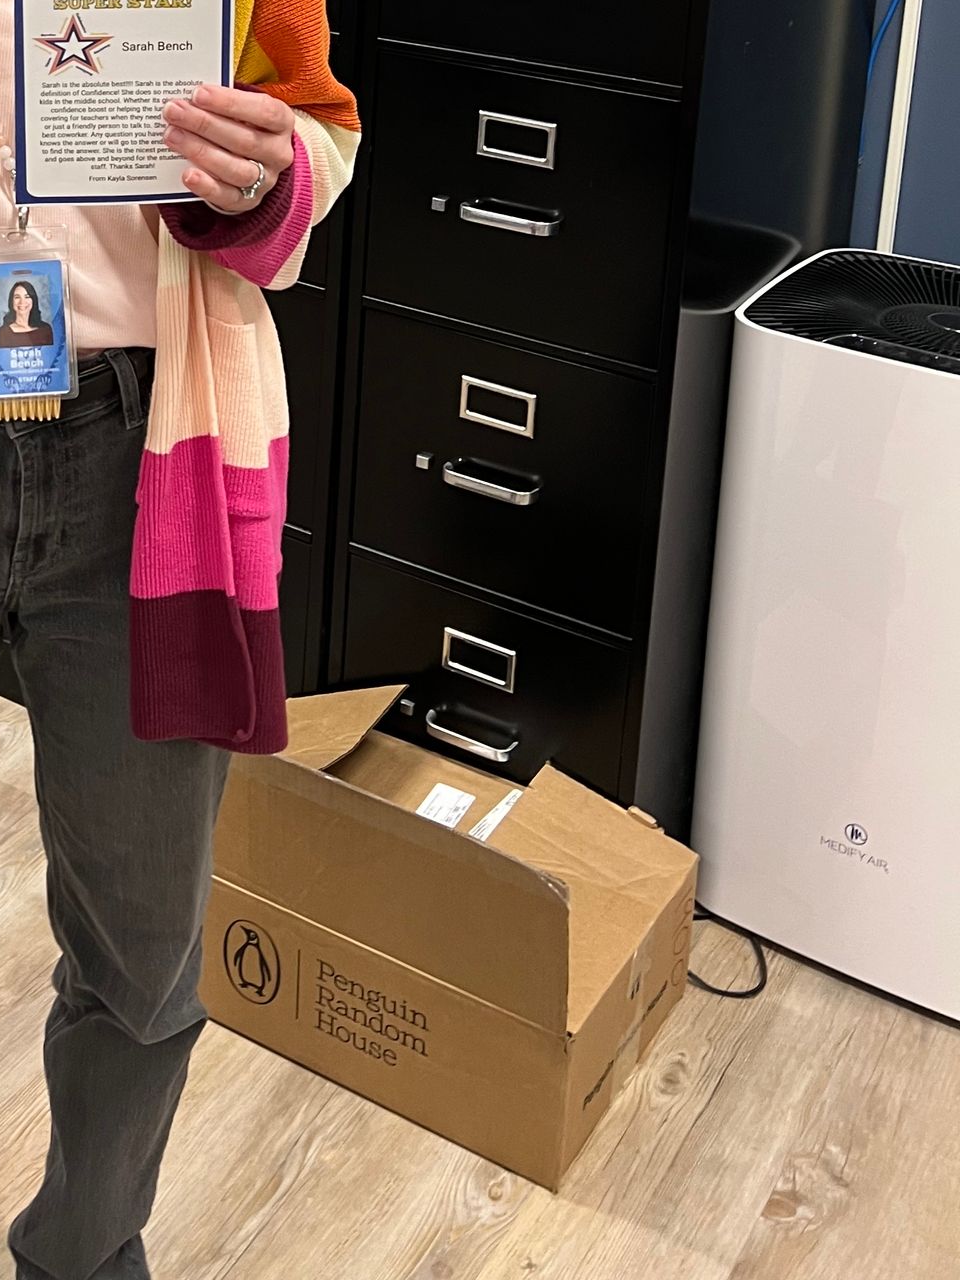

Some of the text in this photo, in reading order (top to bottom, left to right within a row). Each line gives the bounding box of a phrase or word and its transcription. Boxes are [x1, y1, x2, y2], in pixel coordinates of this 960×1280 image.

[122, 41, 193, 51] Sarah Bench
[10, 348, 41, 358] Sarah
[10, 359, 44, 368] Bench
[316, 959, 431, 1032] Penguin
[314, 1008, 397, 1067] House
[315, 984, 429, 1057] Random
